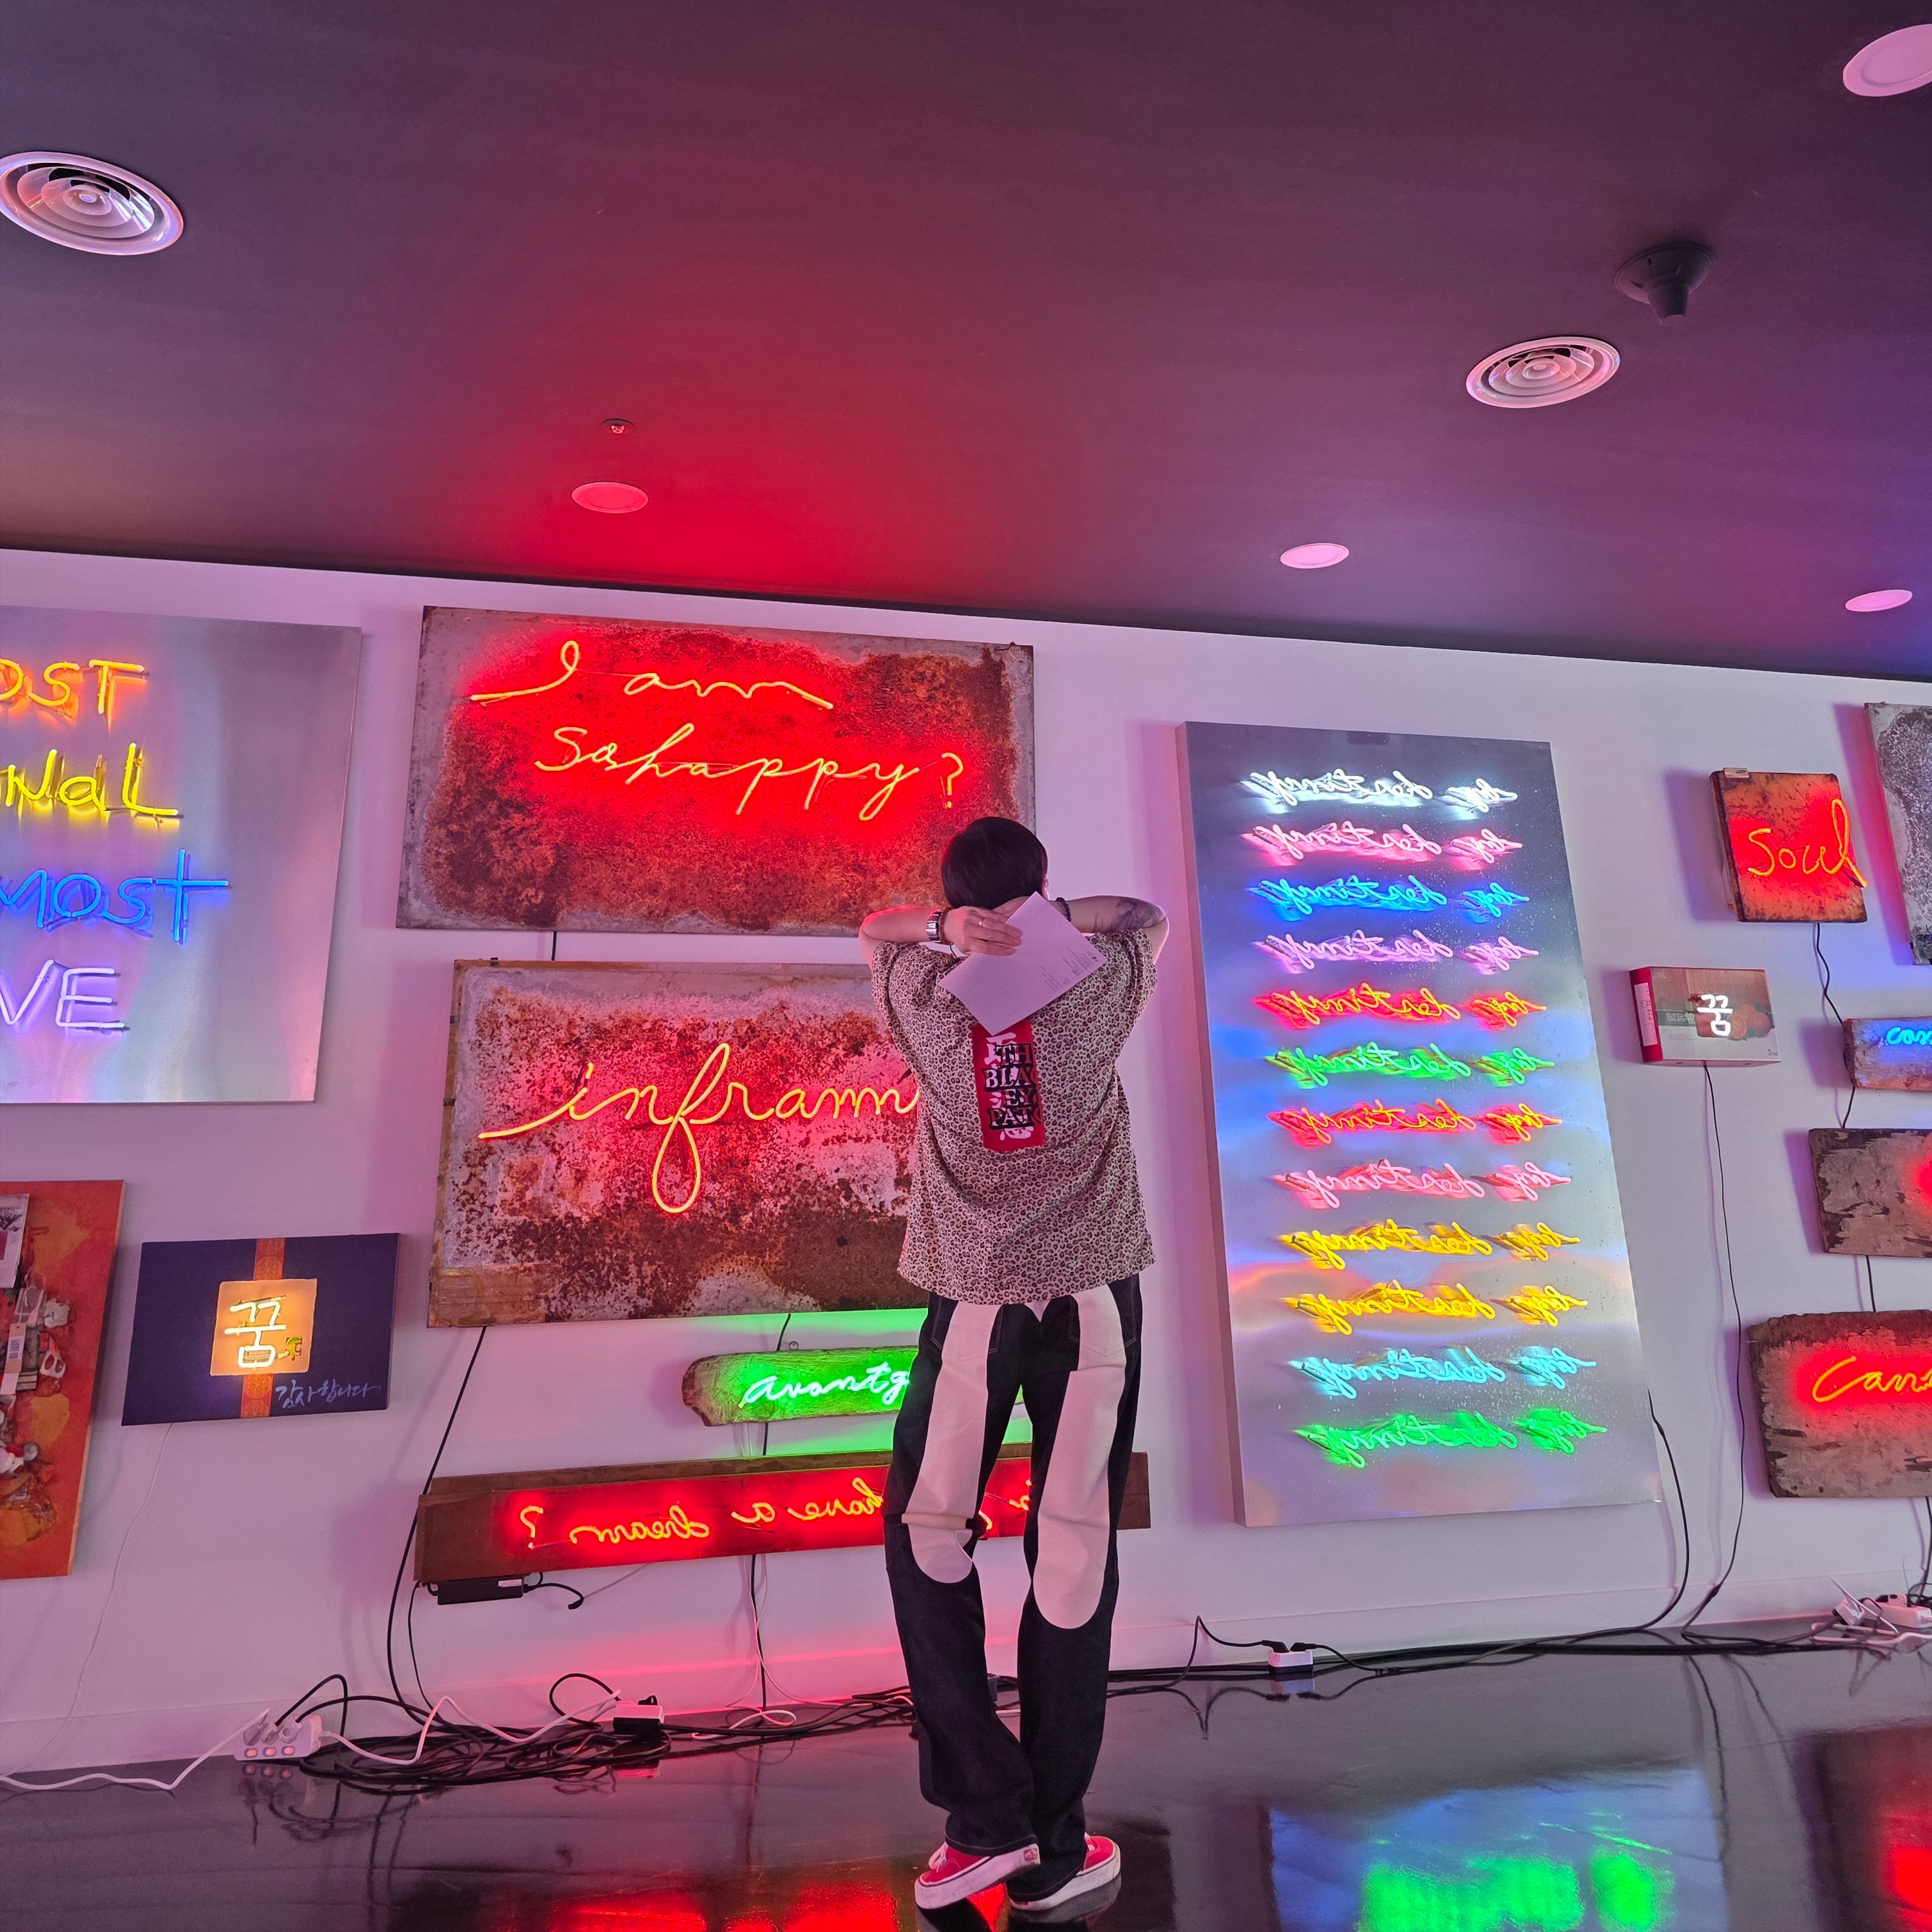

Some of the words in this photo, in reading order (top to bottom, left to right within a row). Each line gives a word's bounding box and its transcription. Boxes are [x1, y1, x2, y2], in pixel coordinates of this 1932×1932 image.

[470, 640, 580, 701] I
[623, 672, 833, 709] am
[1747, 798, 1867, 887] Soul
[1696, 994, 1733, 1036] 꿈
[225, 1300, 287, 1368] 꿈
[276, 1379, 381, 1408] 감사합니다
